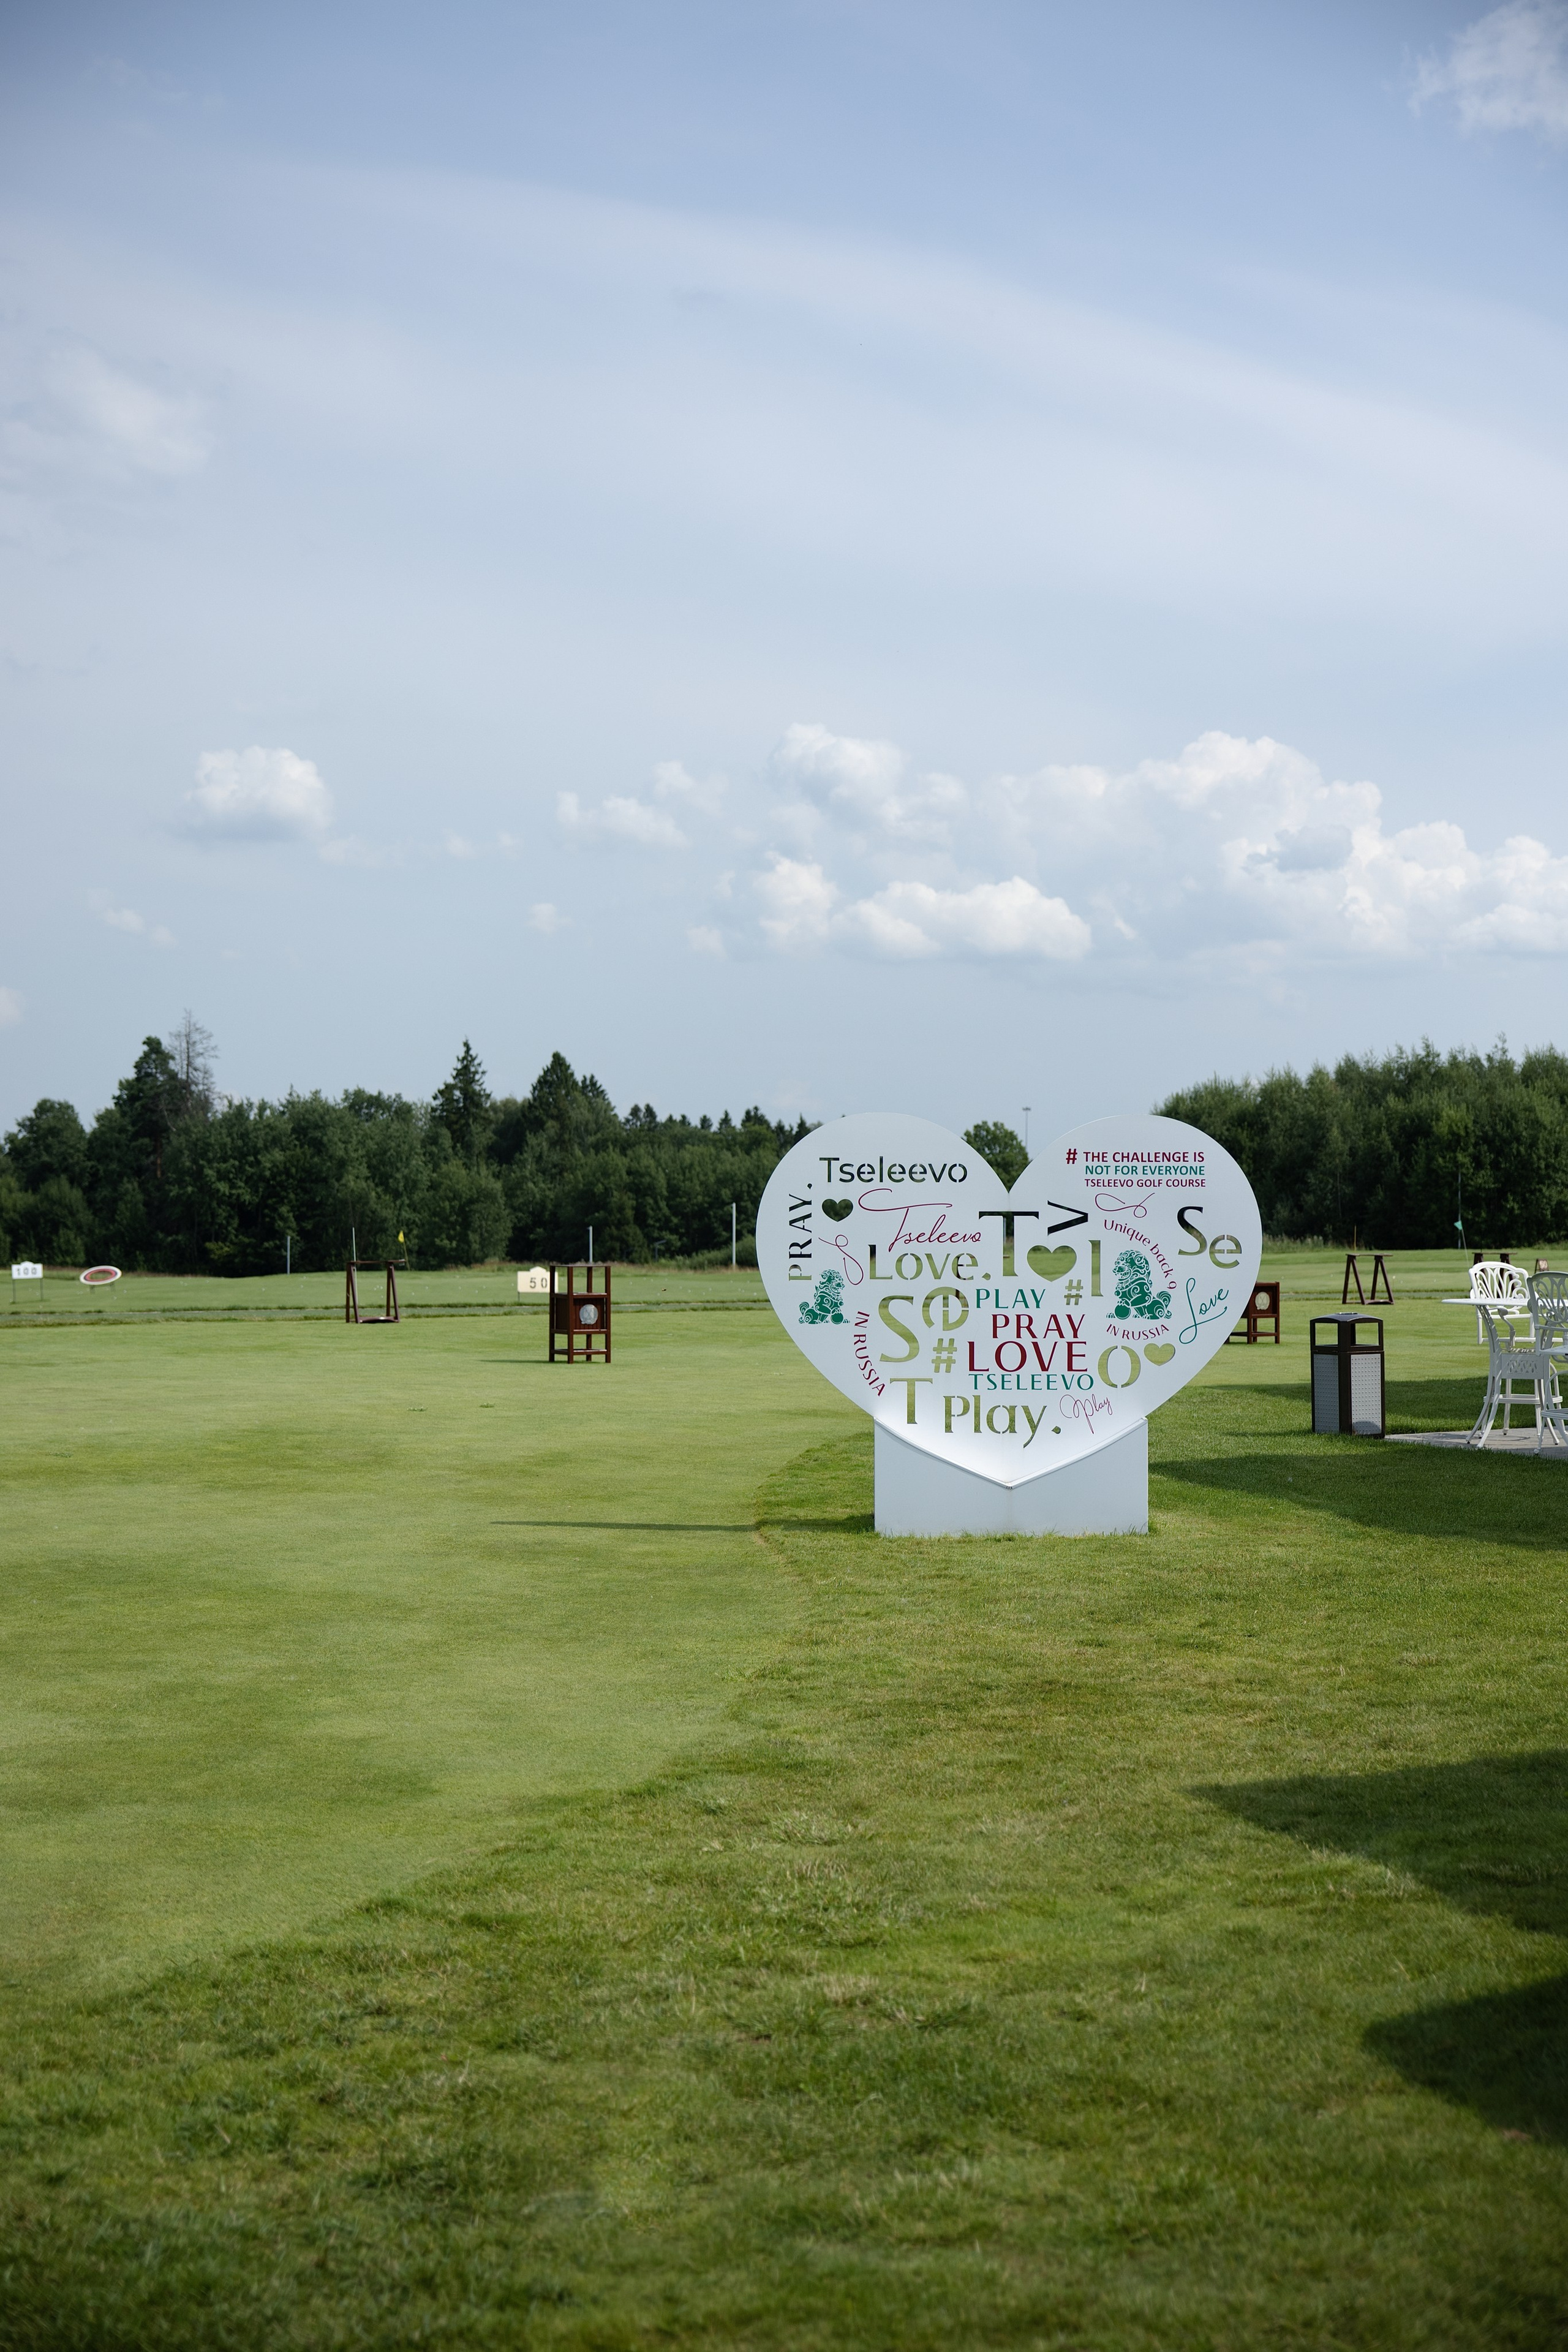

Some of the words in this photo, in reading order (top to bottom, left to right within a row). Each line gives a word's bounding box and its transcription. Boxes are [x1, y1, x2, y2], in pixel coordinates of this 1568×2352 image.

[819, 1156, 968, 1183] Tseleevo
[1083, 1152, 1108, 1163] THE
[1112, 1152, 1189, 1163] CHALLENGE
[1193, 1152, 1205, 1163] IS
[1085, 1165, 1111, 1175] NOT
[1115, 1165, 1138, 1175] FOR
[1142, 1165, 1205, 1175] EVERYONE
[1085, 1178, 1134, 1187] TSELEEVO
[1137, 1178, 1163, 1187] GOLF
[1166, 1178, 1206, 1187] COURSE
[858, 1188, 981, 1252] Tseleevo
[1104, 1219, 1151, 1247] Unique
[1150, 1243, 1174, 1278] back
[868, 1244, 991, 1280] Love.
[530, 1278, 548, 1289] 50
[976, 1289, 1046, 1309] PLAY
[1179, 1278, 1229, 1344] Love
[854, 1311, 870, 1328] IN
[991, 1314, 1085, 1338] PRAY
[1106, 1324, 1120, 1336] IN
[1122, 1324, 1170, 1340] RUSSIA
[853, 1333, 886, 1396] RUSSIA
[967, 1341, 1088, 1373] LOVE
[968, 1374, 1095, 1390] TSELEEVO
[943, 1395, 1061, 1449] Play.
